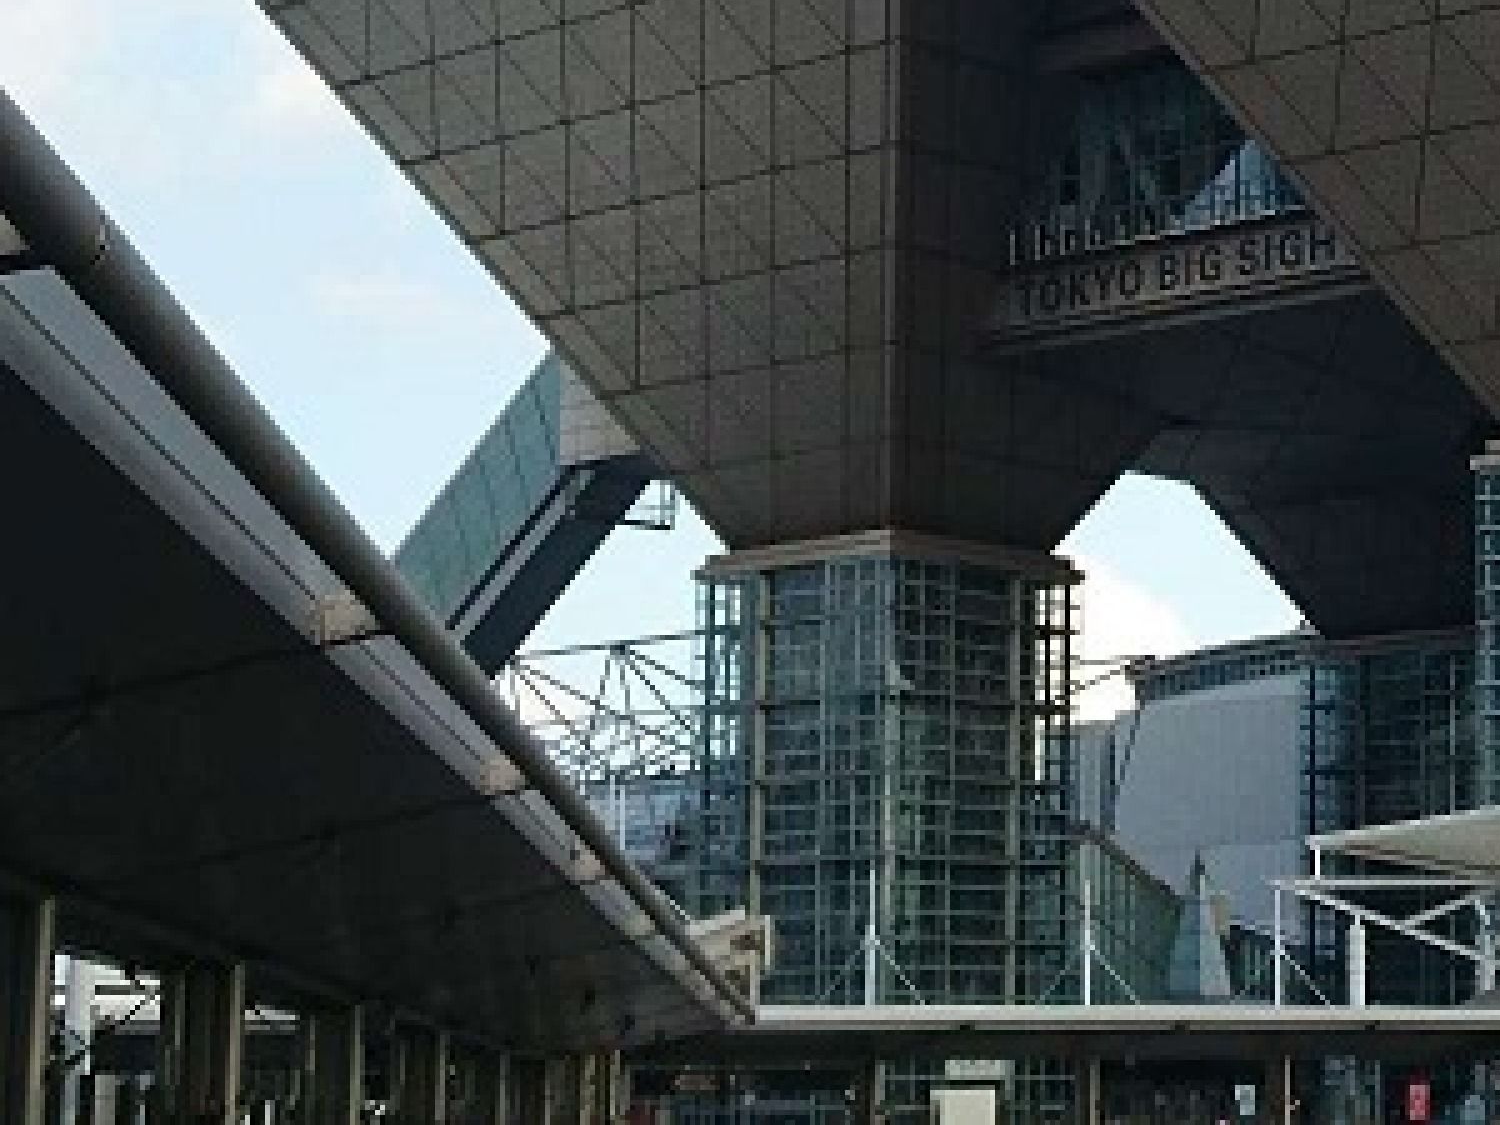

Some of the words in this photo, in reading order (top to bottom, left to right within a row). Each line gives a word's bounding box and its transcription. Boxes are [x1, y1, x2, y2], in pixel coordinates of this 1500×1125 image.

[1014, 257, 1142, 317] TOKYO
[1158, 248, 1222, 291] BIG
[1238, 222, 1337, 273] SIGH
